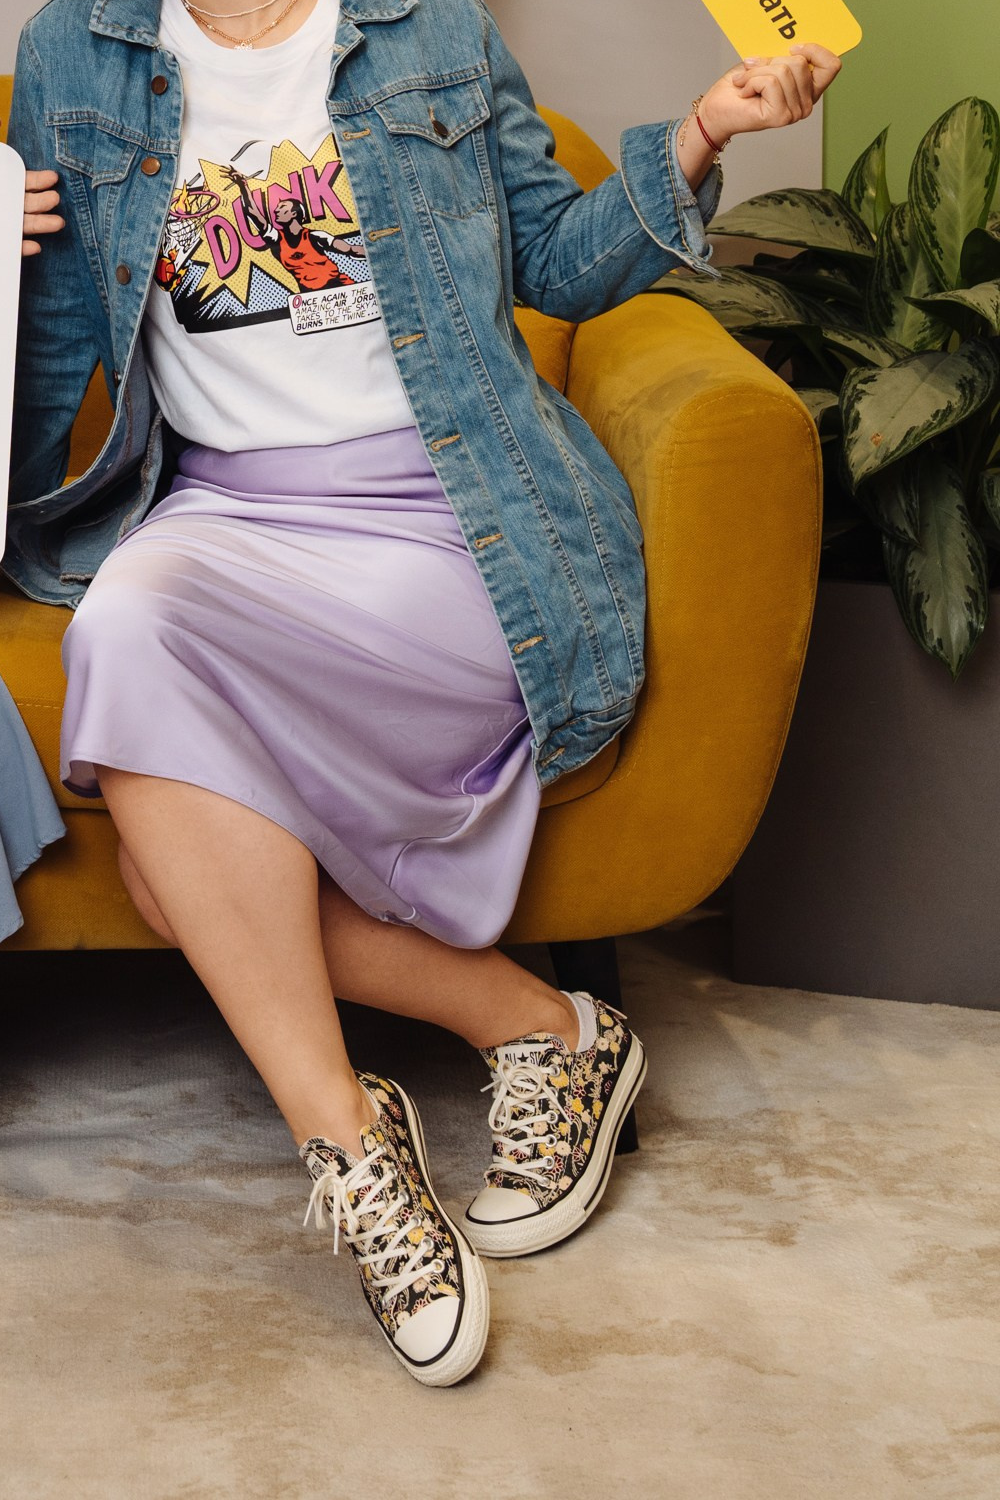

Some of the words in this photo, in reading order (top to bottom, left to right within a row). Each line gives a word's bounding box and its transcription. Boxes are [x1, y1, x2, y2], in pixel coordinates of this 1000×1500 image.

[203, 159, 352, 280] DUNK
[292, 294, 318, 309] ONCE
[322, 291, 348, 303] AGAIN,
[351, 286, 368, 297] THE
[295, 302, 331, 315] AMAZING
[333, 299, 347, 309] AIR
[352, 292, 377, 305] JORD
[296, 312, 321, 323] TAKES
[324, 309, 335, 318] TO
[337, 305, 352, 315] THE
[355, 301, 371, 312] SKY
[296, 319, 323, 331] BURNS
[325, 316, 340, 326] THE
